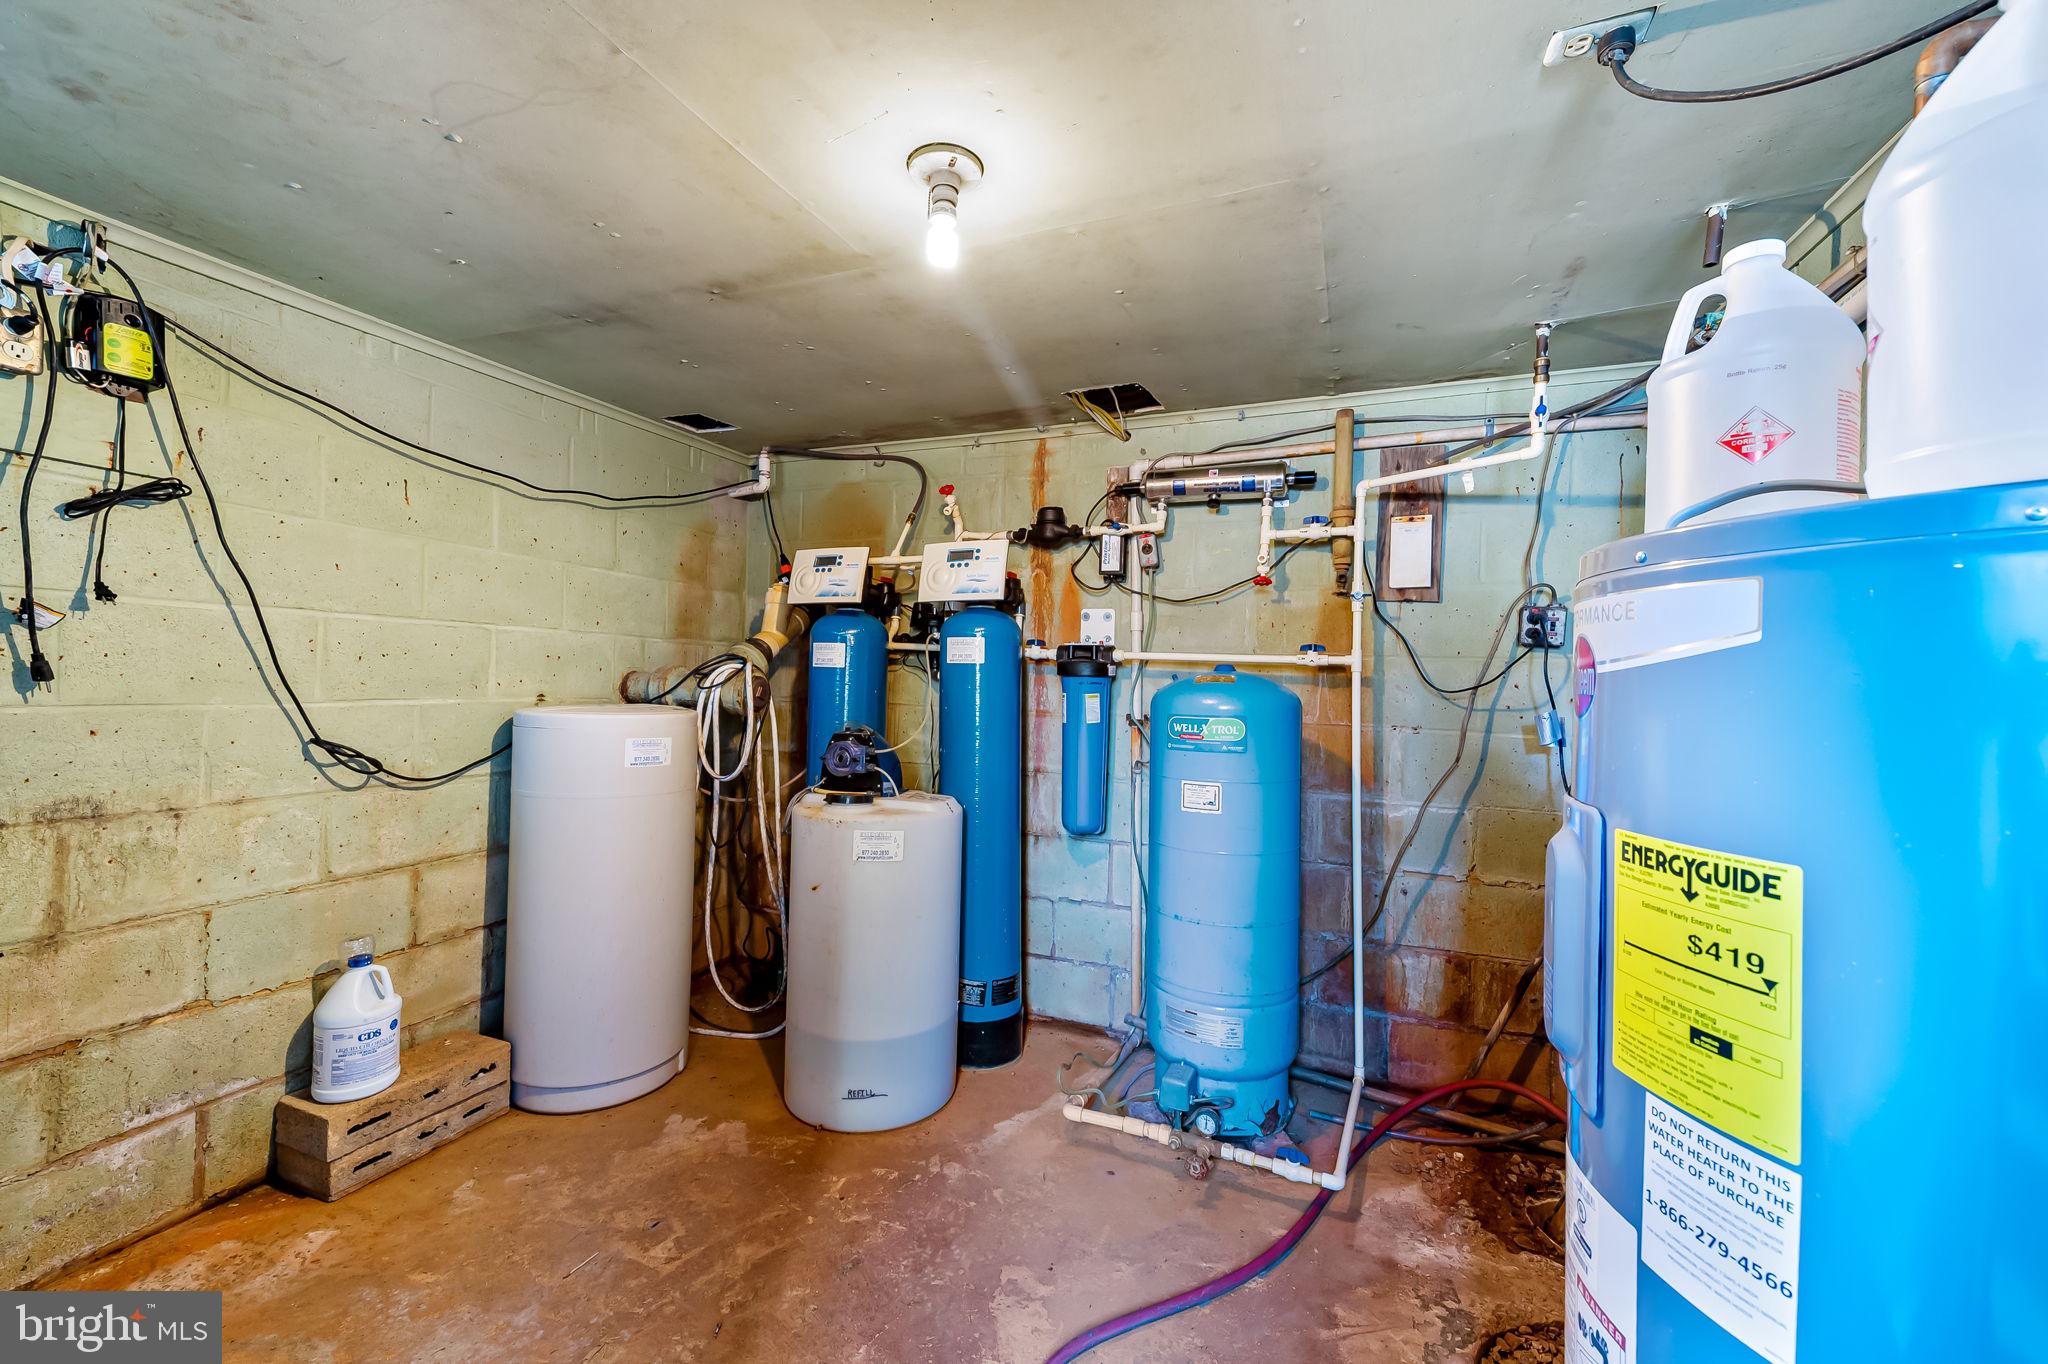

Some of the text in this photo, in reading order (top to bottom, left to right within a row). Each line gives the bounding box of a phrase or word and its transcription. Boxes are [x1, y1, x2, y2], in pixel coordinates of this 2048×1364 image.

[1621, 840, 1782, 902] ENERGYGUIDE
[1641, 900, 1732, 935] Estimated Yearly Energy Cost
[1687, 934, 1765, 975] $419
[358, 1028, 381, 1041] CDS
[1662, 995, 1717, 1026] First Hour Rating
[847, 1089, 876, 1099] REFILL
[1648, 1119, 1795, 1215] WATER HEATER TO THE
[1651, 1105, 1667, 1123] DO
[1669, 1117, 1694, 1139] NOT
[1697, 1134, 1752, 1173] RETURN
[1754, 1165, 1791, 1193] THIS
[1653, 1140, 1786, 1229] PLACE OF PURCHASE
[1645, 1188, 1794, 1299] 1-866-279-4566
